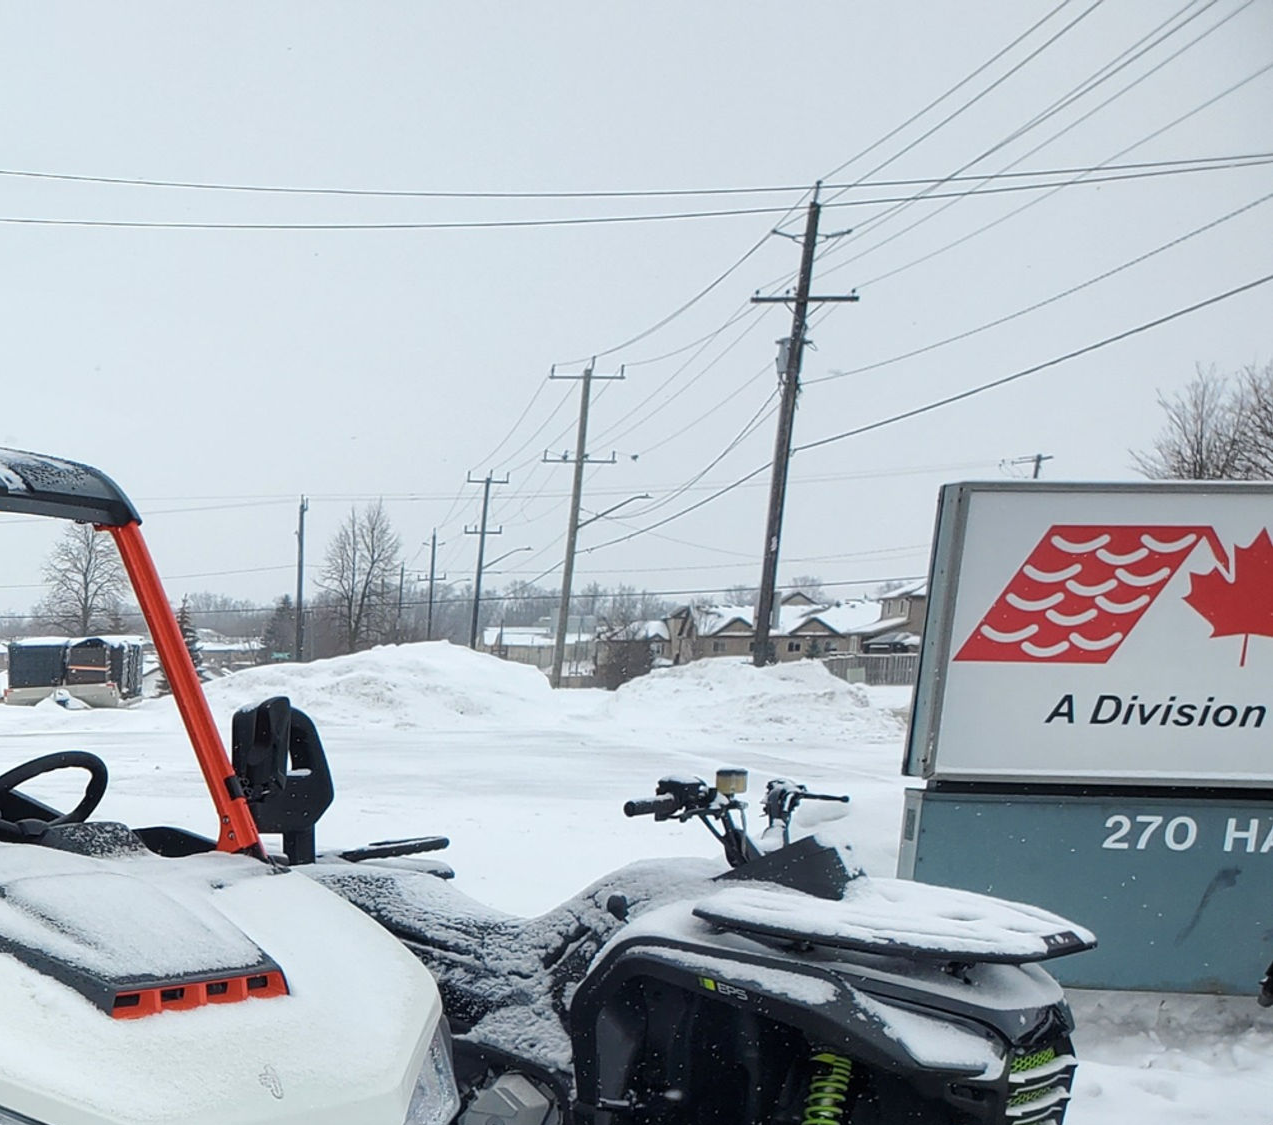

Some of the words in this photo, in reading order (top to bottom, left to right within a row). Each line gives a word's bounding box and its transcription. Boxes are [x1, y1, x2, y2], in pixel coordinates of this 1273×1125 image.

[1044, 694, 1075, 724] A
[1089, 694, 1267, 728] Division
[1101, 814, 1198, 851] 270
[717, 982, 748, 1001] EPS
